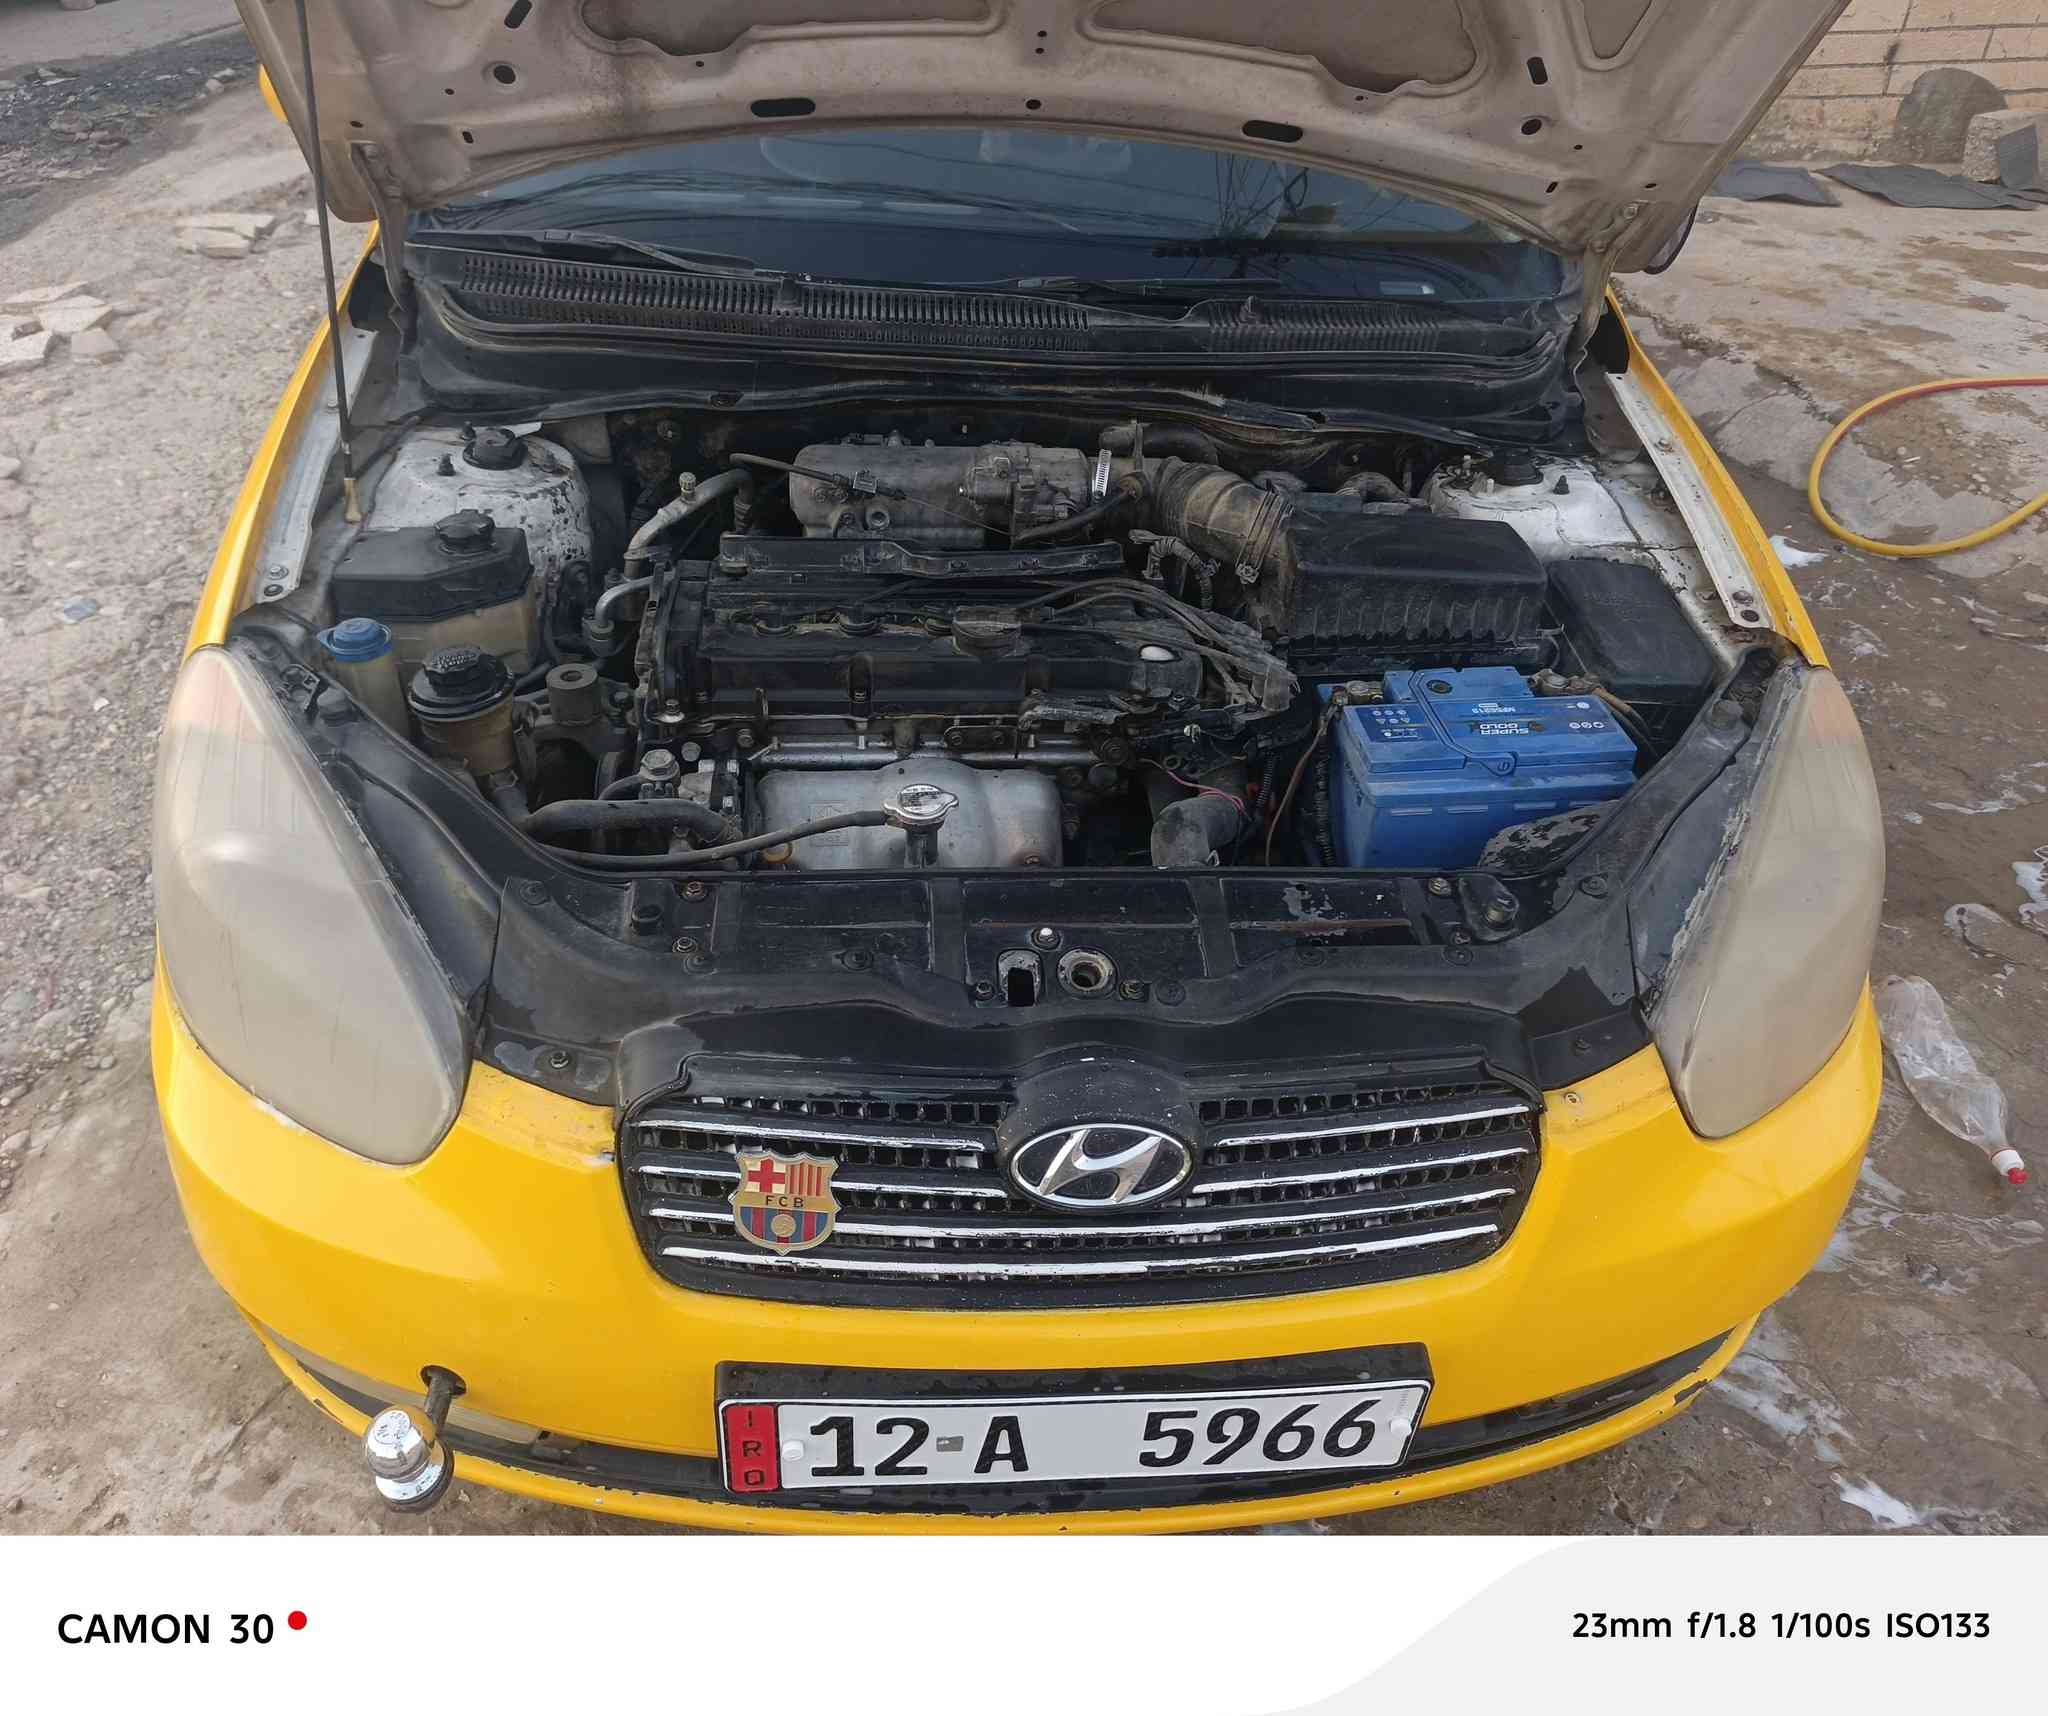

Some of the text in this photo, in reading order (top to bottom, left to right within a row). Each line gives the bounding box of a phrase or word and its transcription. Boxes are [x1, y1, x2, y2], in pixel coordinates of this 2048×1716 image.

[765, 1195, 804, 1208] FCB
[973, 1416, 1029, 1474] A
[1139, 1399, 1381, 1468] 5966
